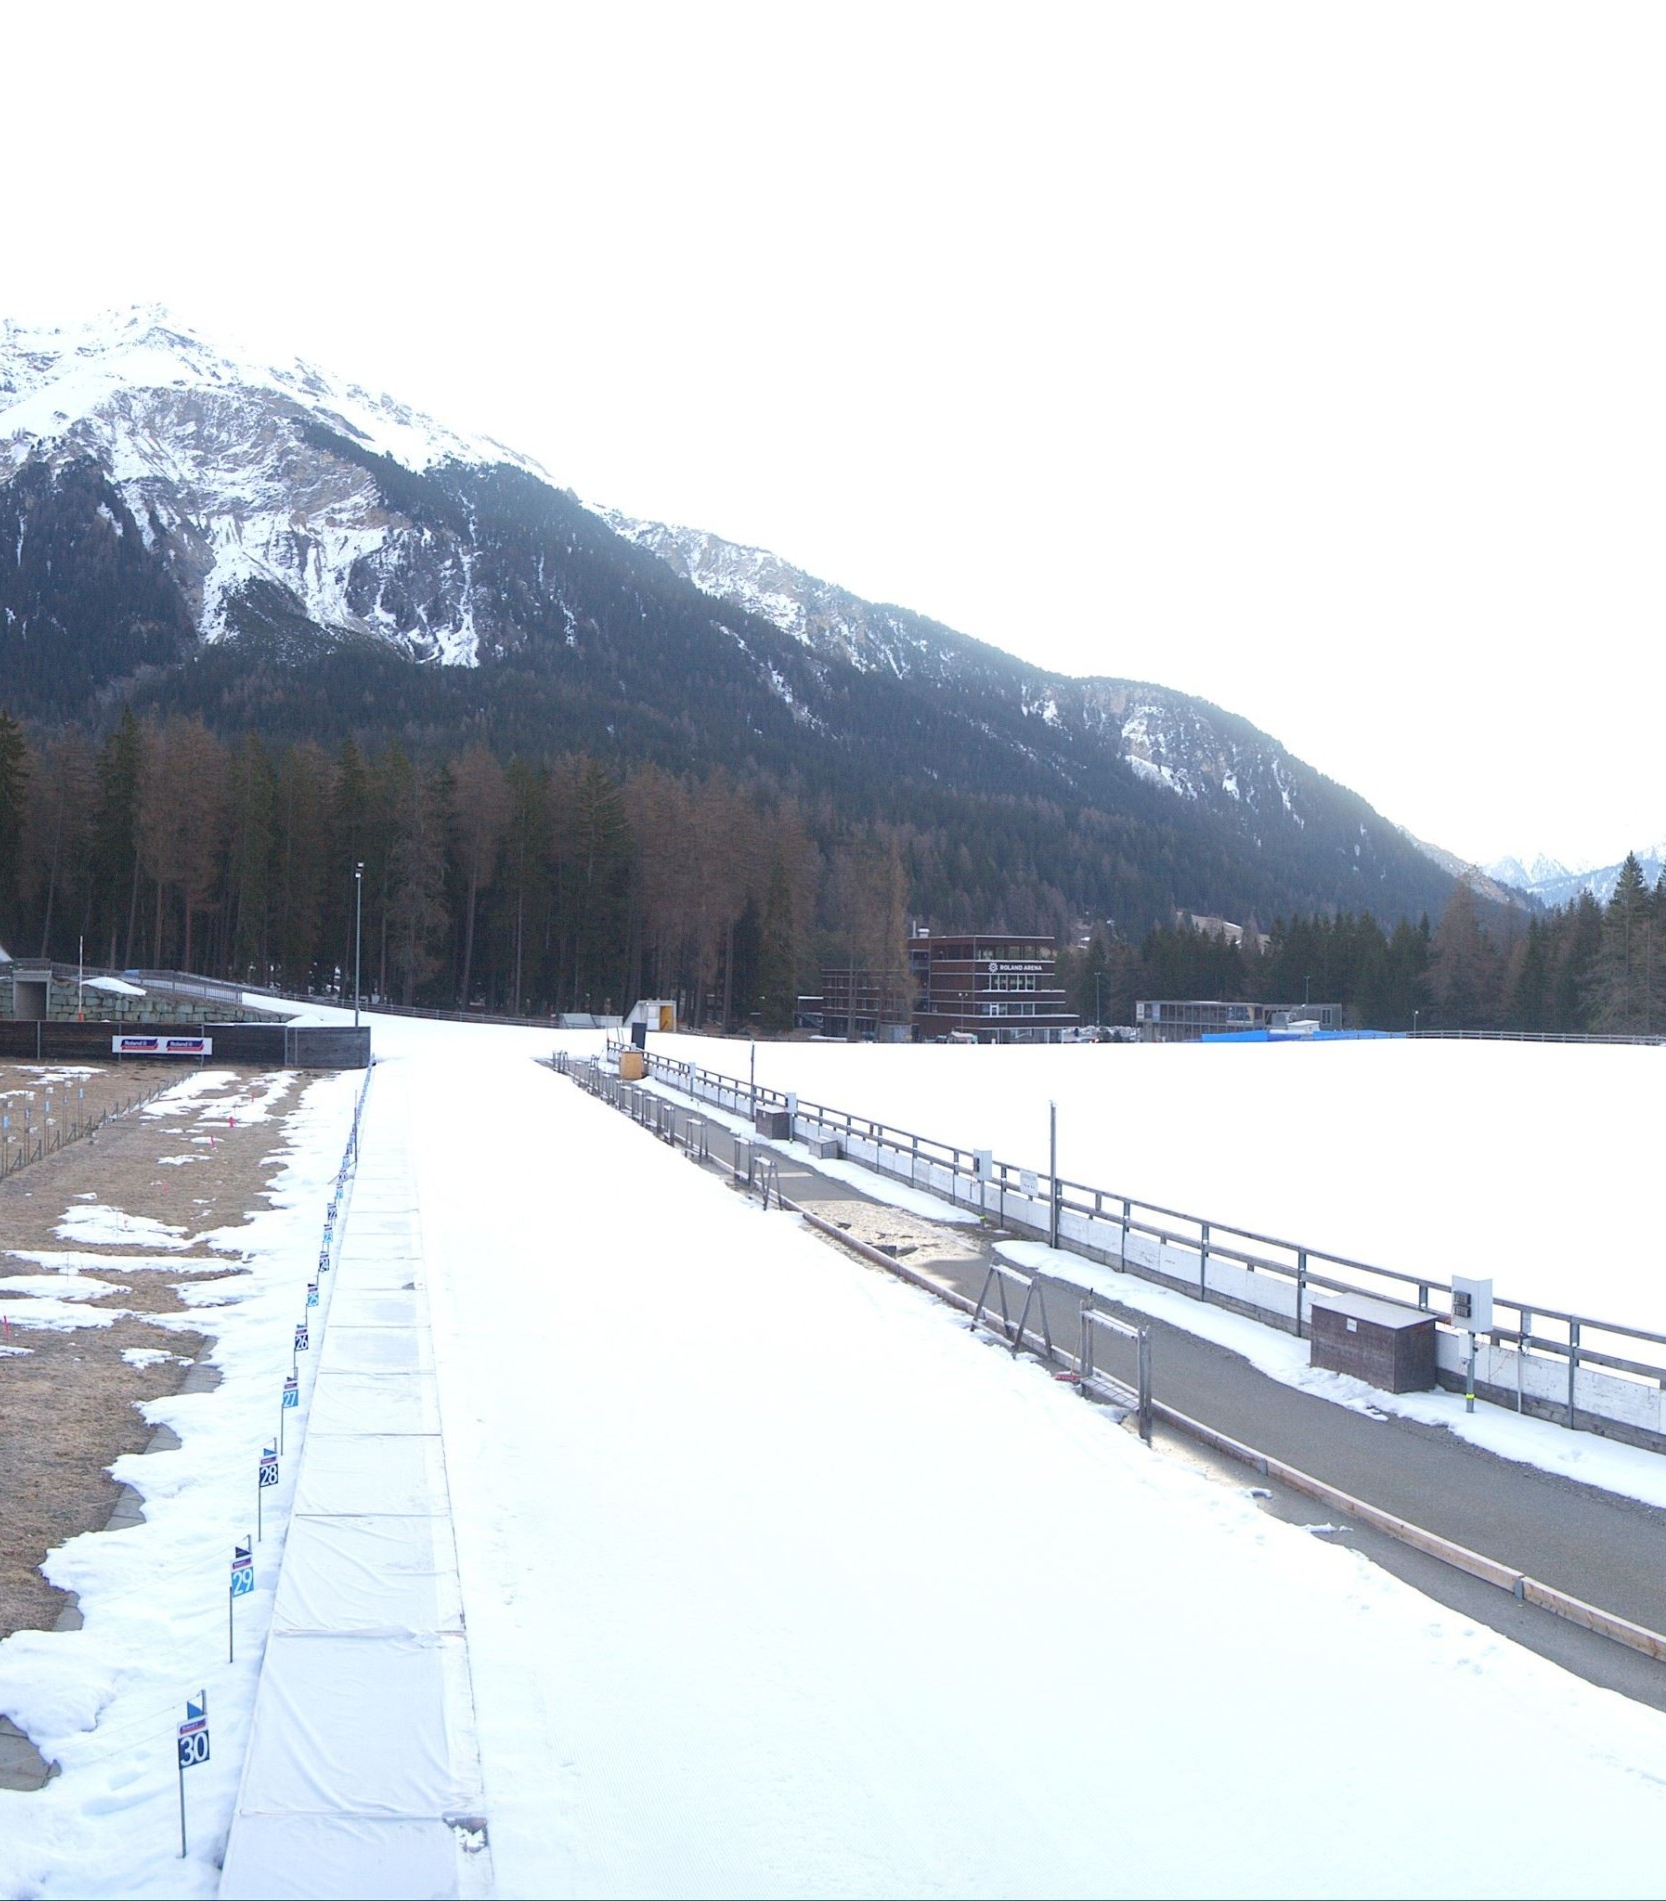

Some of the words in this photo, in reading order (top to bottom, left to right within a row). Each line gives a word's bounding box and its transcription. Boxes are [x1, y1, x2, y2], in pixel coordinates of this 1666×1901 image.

[296, 1336, 308, 1350] 26
[283, 1390, 297, 1408] 27
[261, 1465, 278, 1486] 28
[233, 1568, 253, 1597] 29
[179, 1731, 209, 1767] 30
